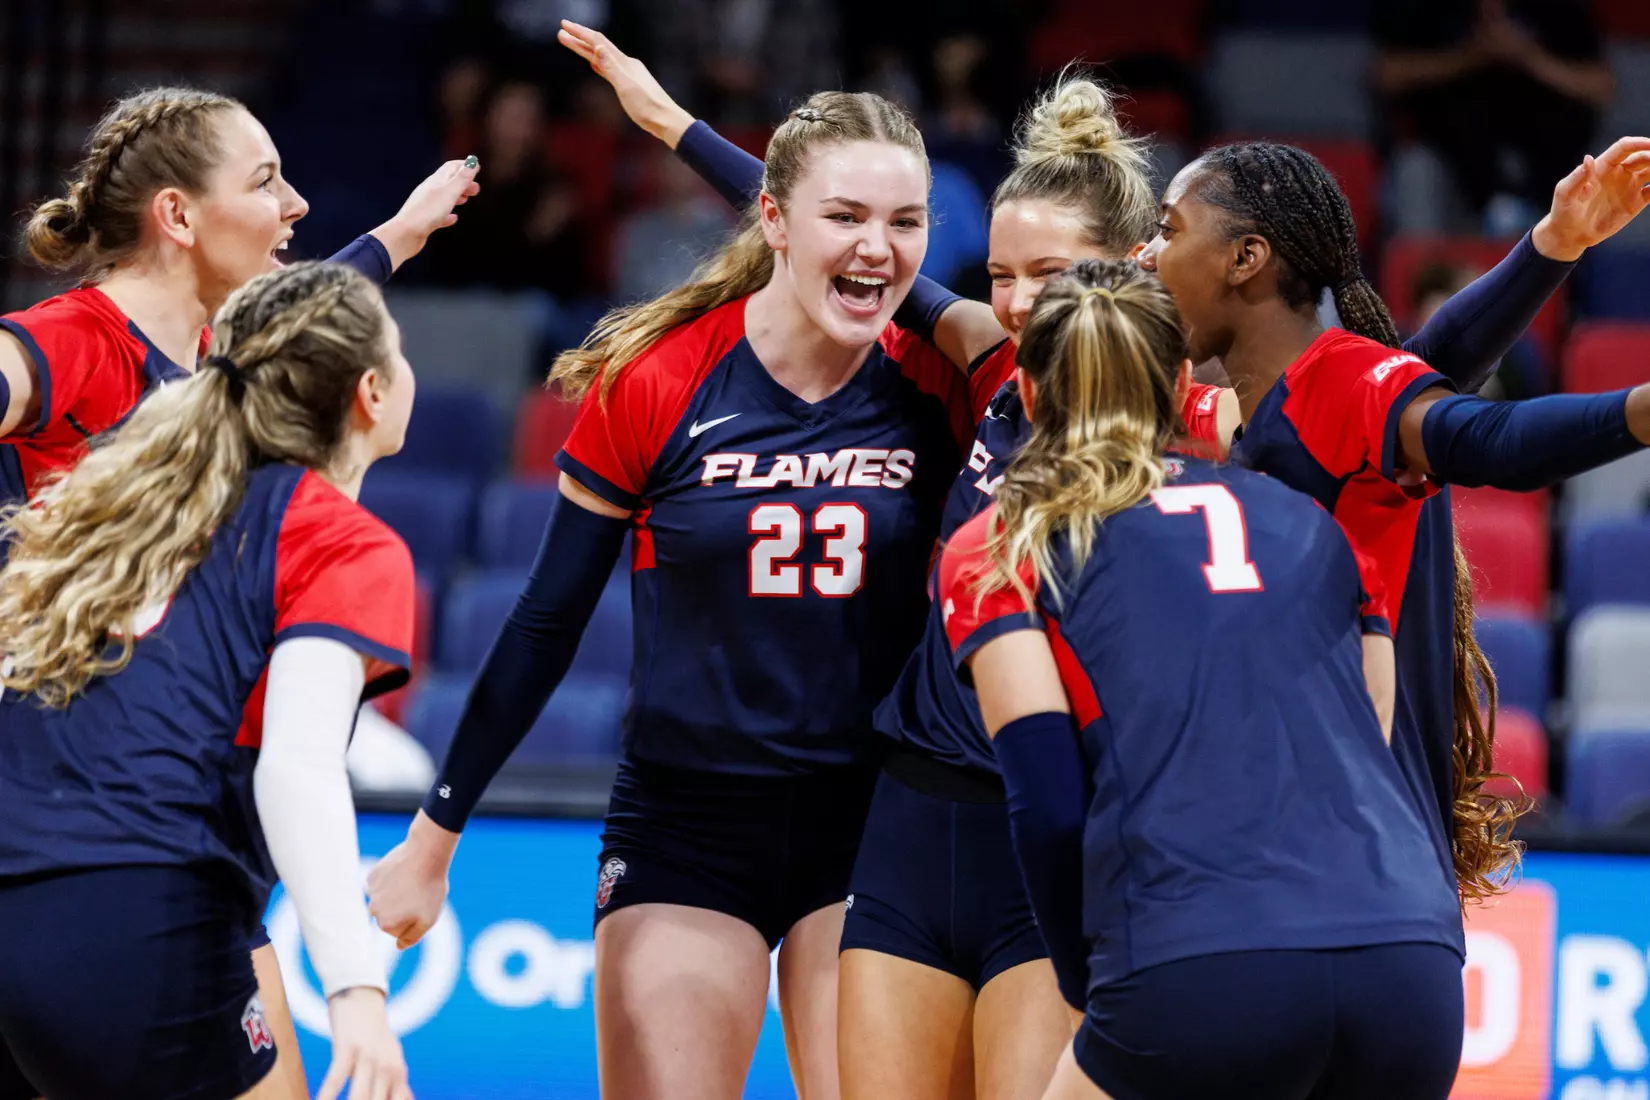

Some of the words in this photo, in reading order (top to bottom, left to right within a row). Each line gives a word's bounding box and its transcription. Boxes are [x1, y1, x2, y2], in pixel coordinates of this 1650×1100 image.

[701, 448, 916, 489] FLAMES
[747, 502, 868, 598] 23
[1149, 482, 1264, 595] 7
